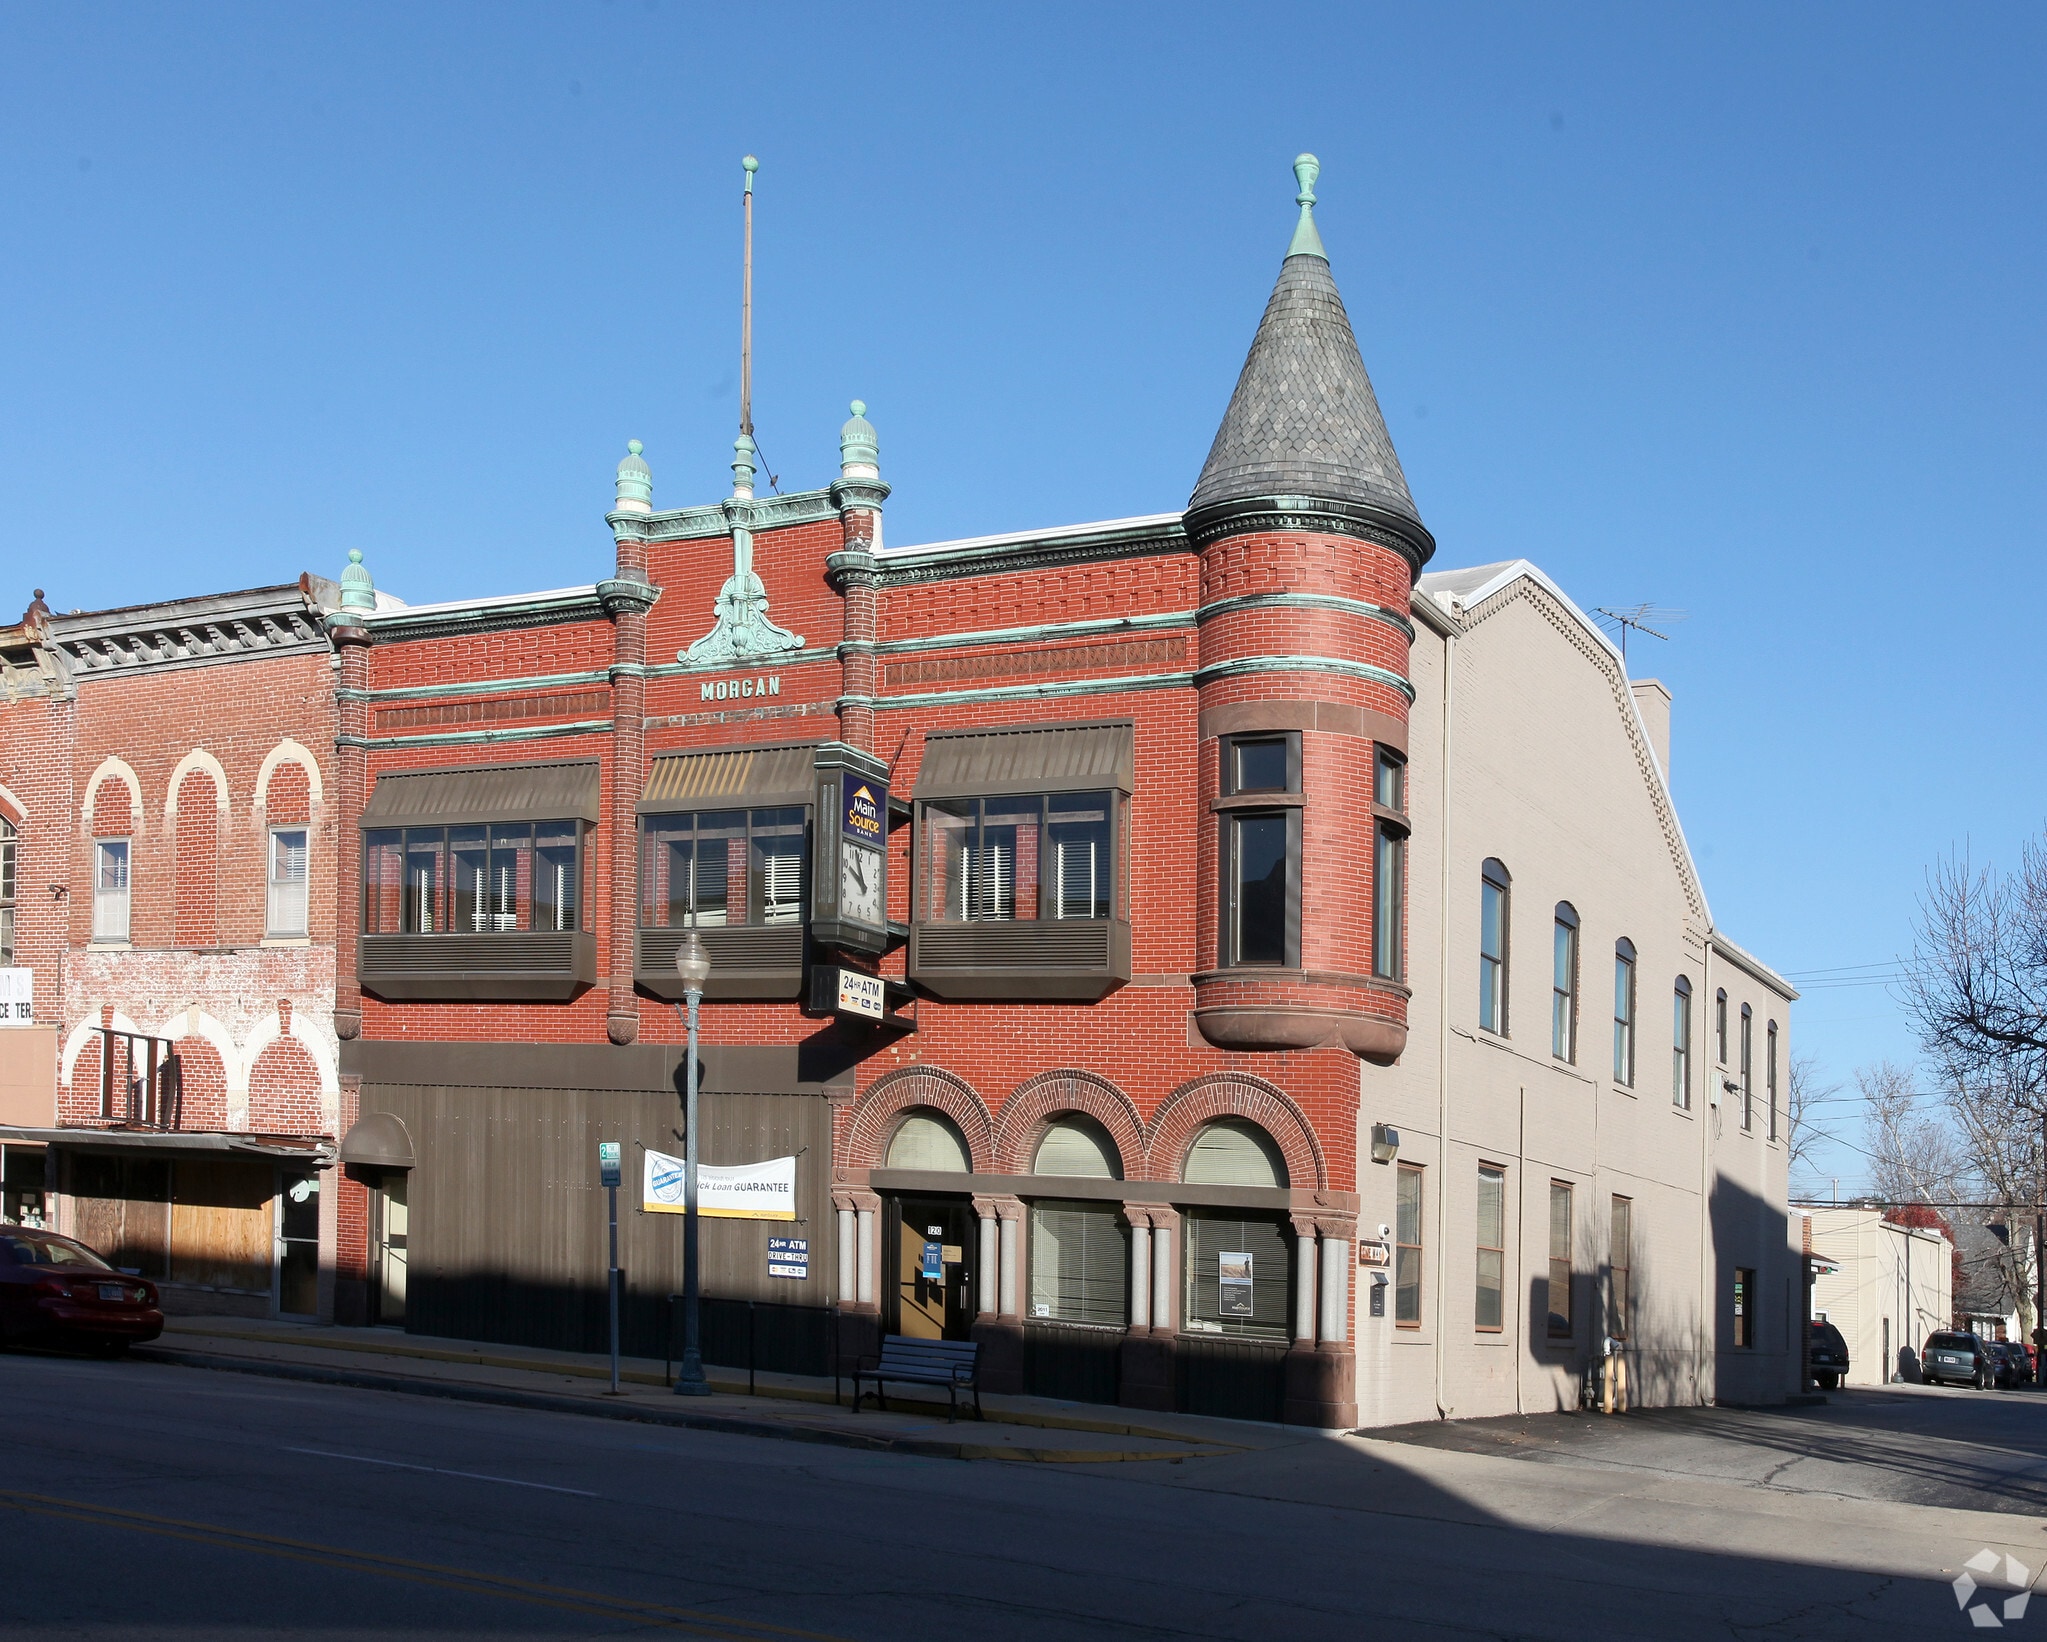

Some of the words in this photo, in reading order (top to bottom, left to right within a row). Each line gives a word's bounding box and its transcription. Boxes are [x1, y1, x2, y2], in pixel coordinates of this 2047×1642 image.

[701, 676, 780, 701] MORGAN
[854, 797, 876, 818] Main
[849, 809, 880, 833] Source
[856, 828, 873, 838] BANK
[842, 872, 847, 883] 9
[842, 888, 847, 898] 8
[861, 980, 879, 997] ATM
[601, 1146, 607, 1158] 2
[696, 1181, 710, 1190] ick
[712, 1182, 732, 1191] Loan
[734, 1182, 789, 1192] GUARANTEE
[928, 1226, 942, 1235] 120
[788, 1240, 806, 1250] ATM
